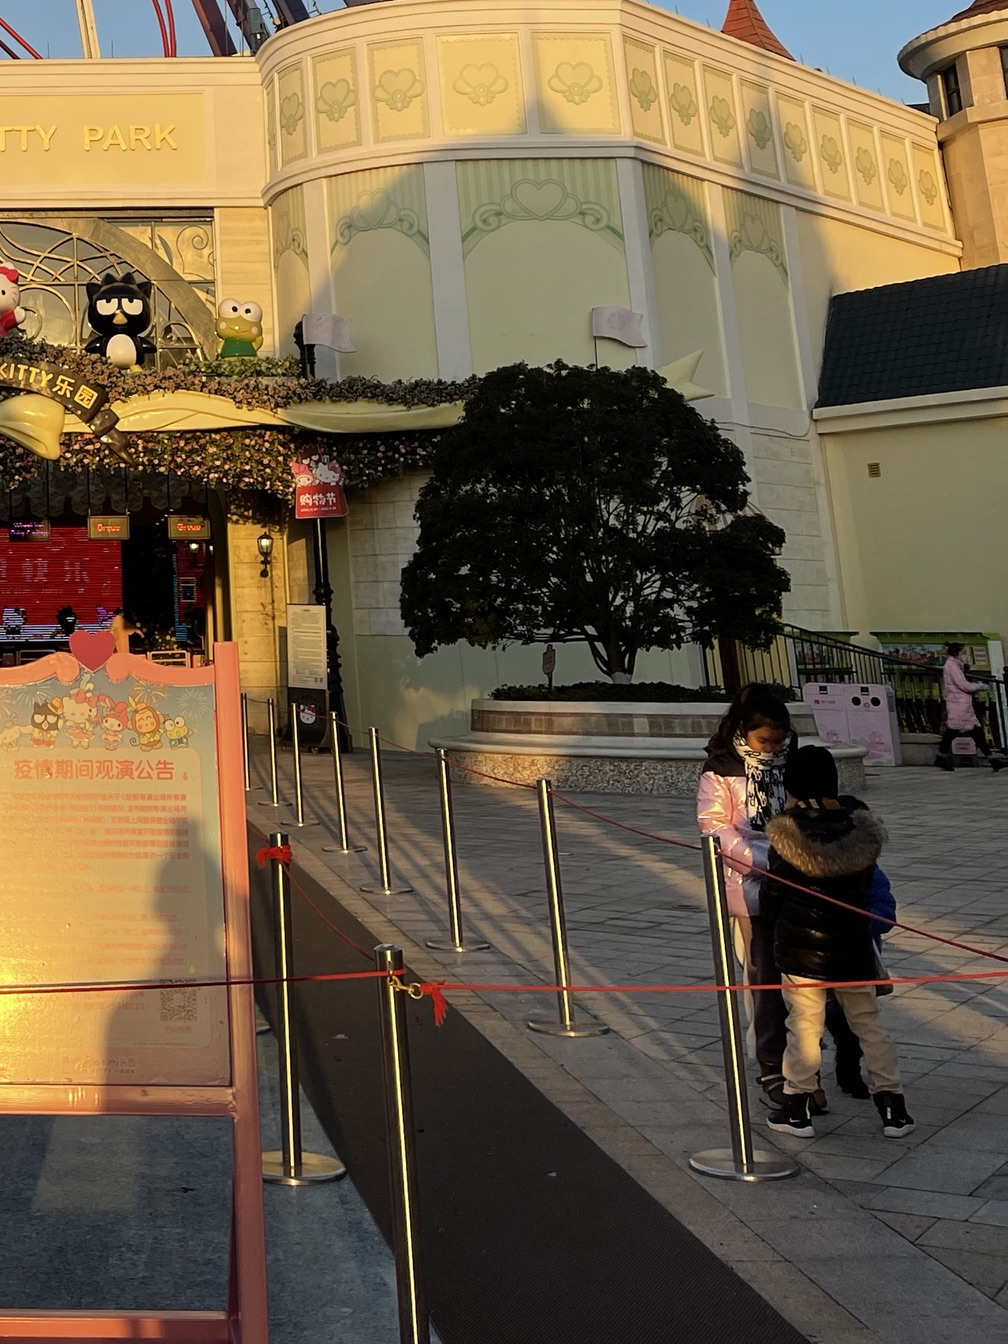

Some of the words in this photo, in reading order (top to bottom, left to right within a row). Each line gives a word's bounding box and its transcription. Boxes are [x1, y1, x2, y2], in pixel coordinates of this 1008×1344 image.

[83, 124, 178, 151] PARK
[52, 375, 98, 409] 乐园
[299, 492, 336, 506] 购物节
[14, 759, 175, 781] 疫情期间观演公告
